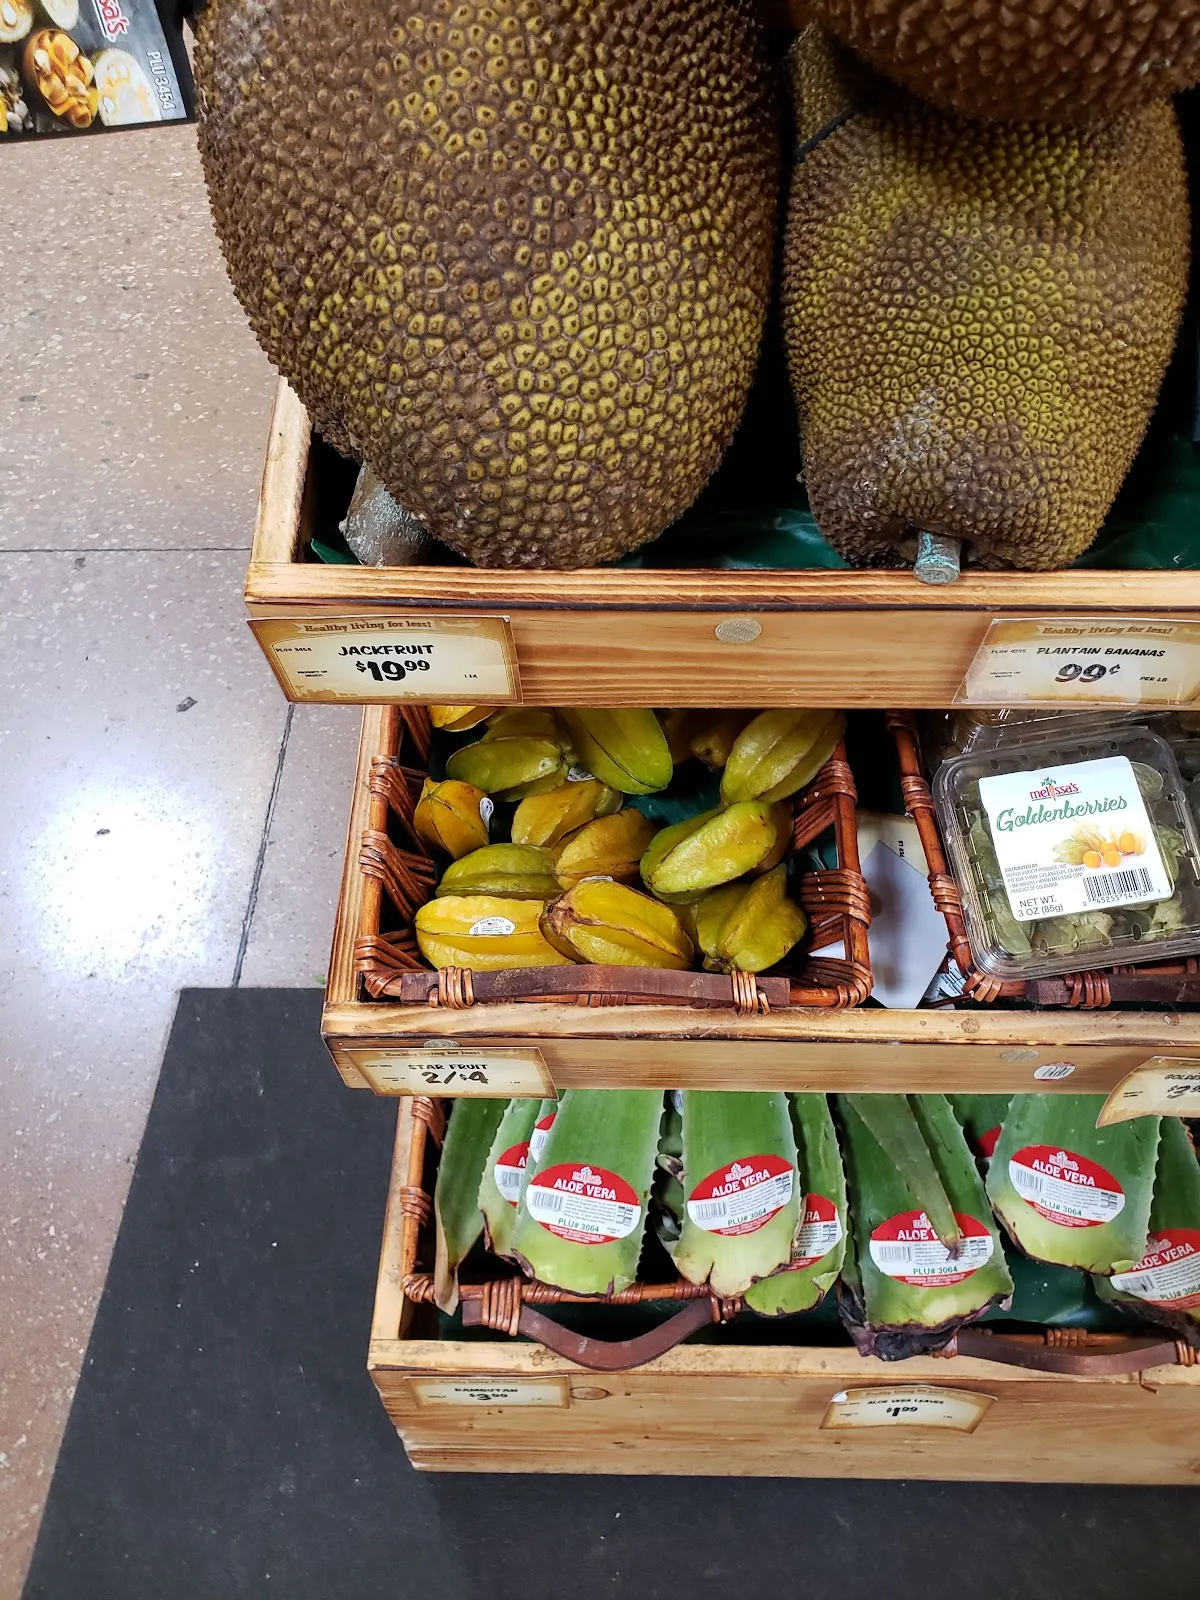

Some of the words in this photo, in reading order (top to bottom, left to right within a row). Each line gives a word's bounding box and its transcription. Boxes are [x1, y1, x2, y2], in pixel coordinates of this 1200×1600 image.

[146, 51, 165, 76] PLU
[155, 77, 176, 111] 3454
[304, 624, 348, 634] Healthy
[350, 622, 385, 631] living
[406, 620, 432, 628] less!
[1042, 627, 1086, 635] Healthy
[1088, 626, 1125, 634] living
[1147, 626, 1173, 634] less!
[337, 644, 434, 656] JACKFRUIT
[1037, 647, 1100, 656] PLANTAIN
[1104, 648, 1166, 657] BANANAS
[996, 795, 1127, 832] Goldenberries
[1019, 898, 1038, 908] NET
[1040, 895, 1057, 905] WT.
[1018, 909, 1024, 917] 3
[1026, 907, 1040, 916] OZ
[1041, 903, 1064, 915] (85g)
[1032, 1159, 1060, 1178] ALOE
[1063, 1168, 1096, 1187] VERA
[553, 1177, 583, 1193] ALOE
[586, 1184, 617, 1200] VERA
[712, 1181, 740, 1198] ALOE
[743, 1169, 771, 1189] VERA
[1040, 1198, 1061, 1211] PLU#
[1063, 1205, 1082, 1217] 3064
[558, 1217, 579, 1229] PLU#
[581, 1221, 600, 1233] 3064
[727, 1215, 749, 1227] PLU#
[750, 1208, 767, 1221] 3064
[897, 1229, 929, 1241] ALOE
[1132, 1255, 1162, 1271] ALOE
[1162, 1243, 1194, 1263] VERA
[912, 1267, 935, 1275] PLU#
[938, 1266, 958, 1274] 3064
[1159, 1290, 1182, 1300] PLU#
